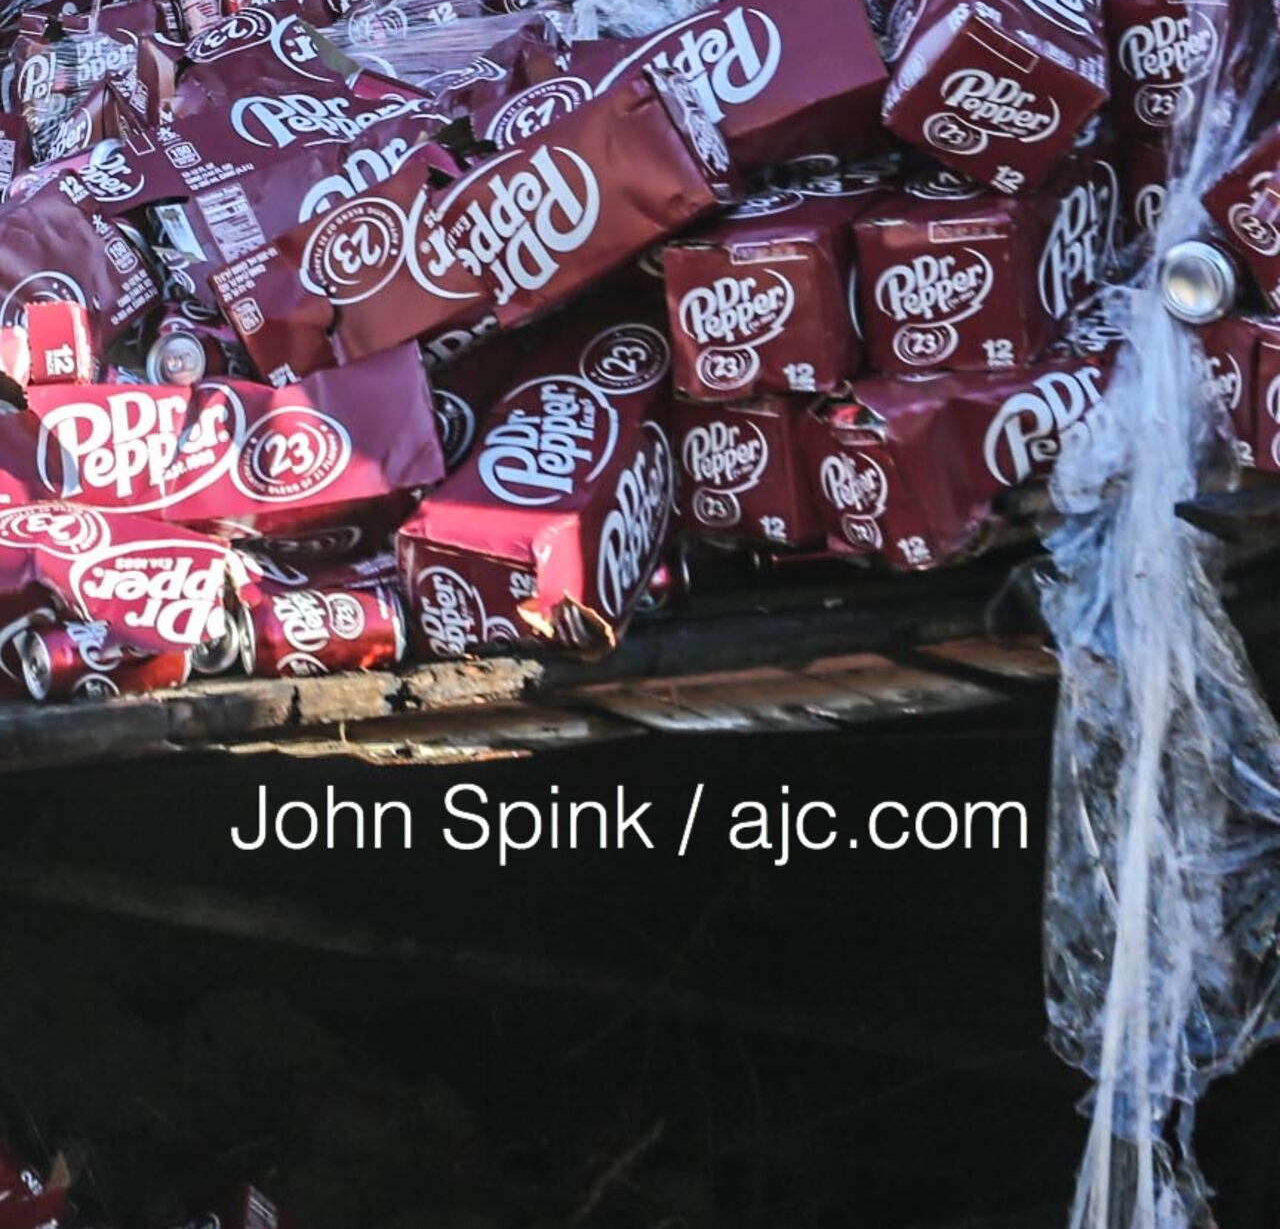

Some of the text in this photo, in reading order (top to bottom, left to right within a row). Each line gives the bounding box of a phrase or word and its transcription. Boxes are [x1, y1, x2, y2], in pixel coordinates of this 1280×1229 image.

[941, 69, 1051, 129] Pepper
[987, 83, 1035, 112] Dr
[58, 168, 83, 193] 12
[337, 226, 379, 270] 23
[716, 275, 756, 307] Dr
[912, 256, 953, 291] Dr
[876, 267, 983, 322] Pepper
[680, 288, 783, 345] Pepper
[46, 345, 75, 373] 12
[601, 341, 648, 379] 23
[784, 364, 815, 388] 12
[1049, 366, 1103, 431] Dr
[110, 391, 181, 449] Dr
[39, 403, 229, 498] Pepper
[266, 433, 312, 476] 23
[479, 384, 577, 506] Pepper
[760, 515, 786, 538] 12
[898, 537, 928, 562] 12
